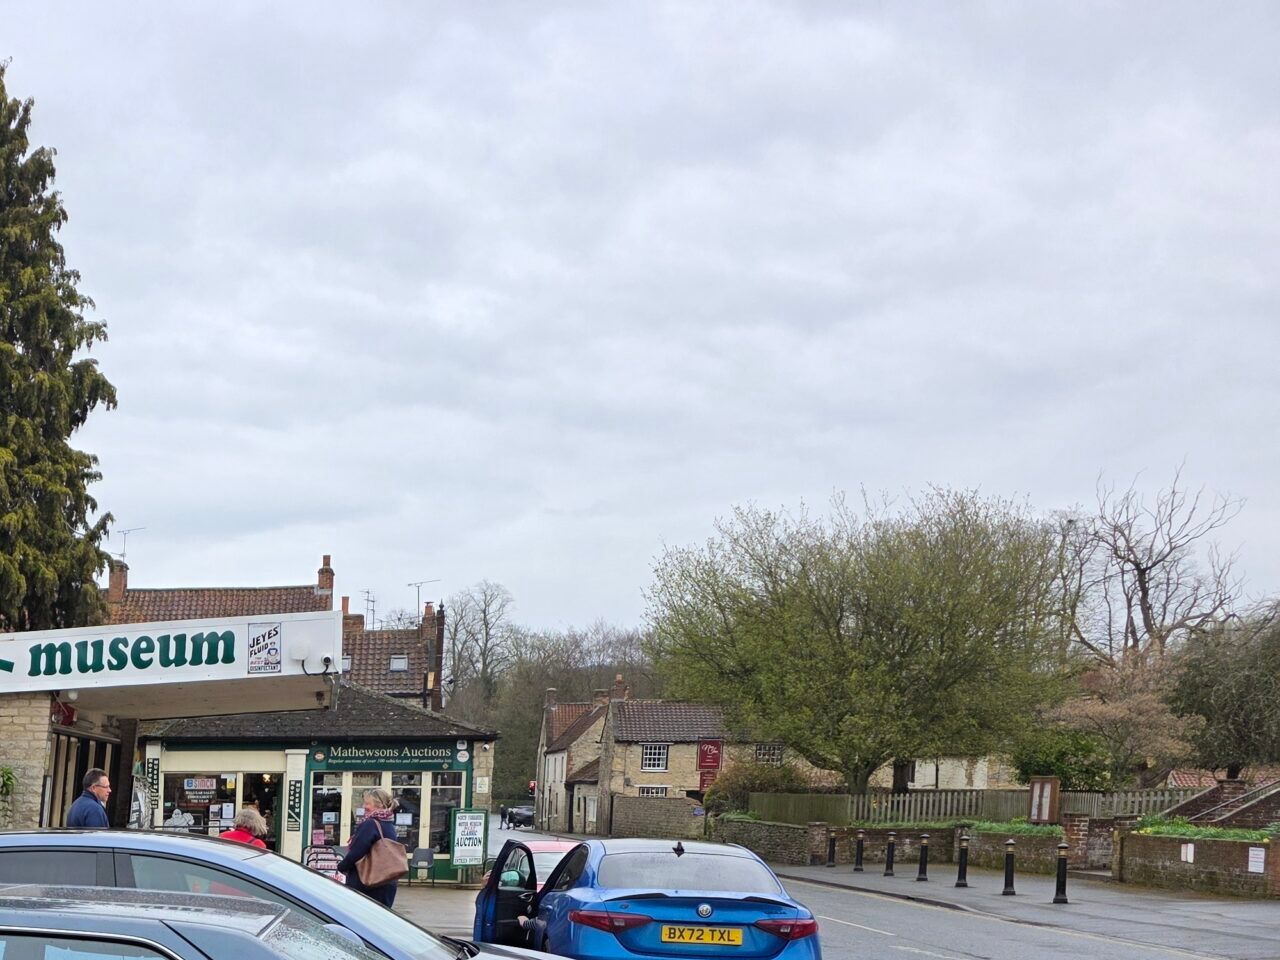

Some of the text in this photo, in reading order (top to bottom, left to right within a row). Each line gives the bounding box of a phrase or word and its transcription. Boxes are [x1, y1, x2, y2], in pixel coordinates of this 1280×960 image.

[27, 630, 236, 677] museum
[249, 642, 269, 658] FLUID
[330, 746, 399, 757] Mathewsons
[401, 746, 452, 757] Auctions
[455, 837, 482, 847] AUCTION
[667, 927, 736, 942] BX72 TXL
